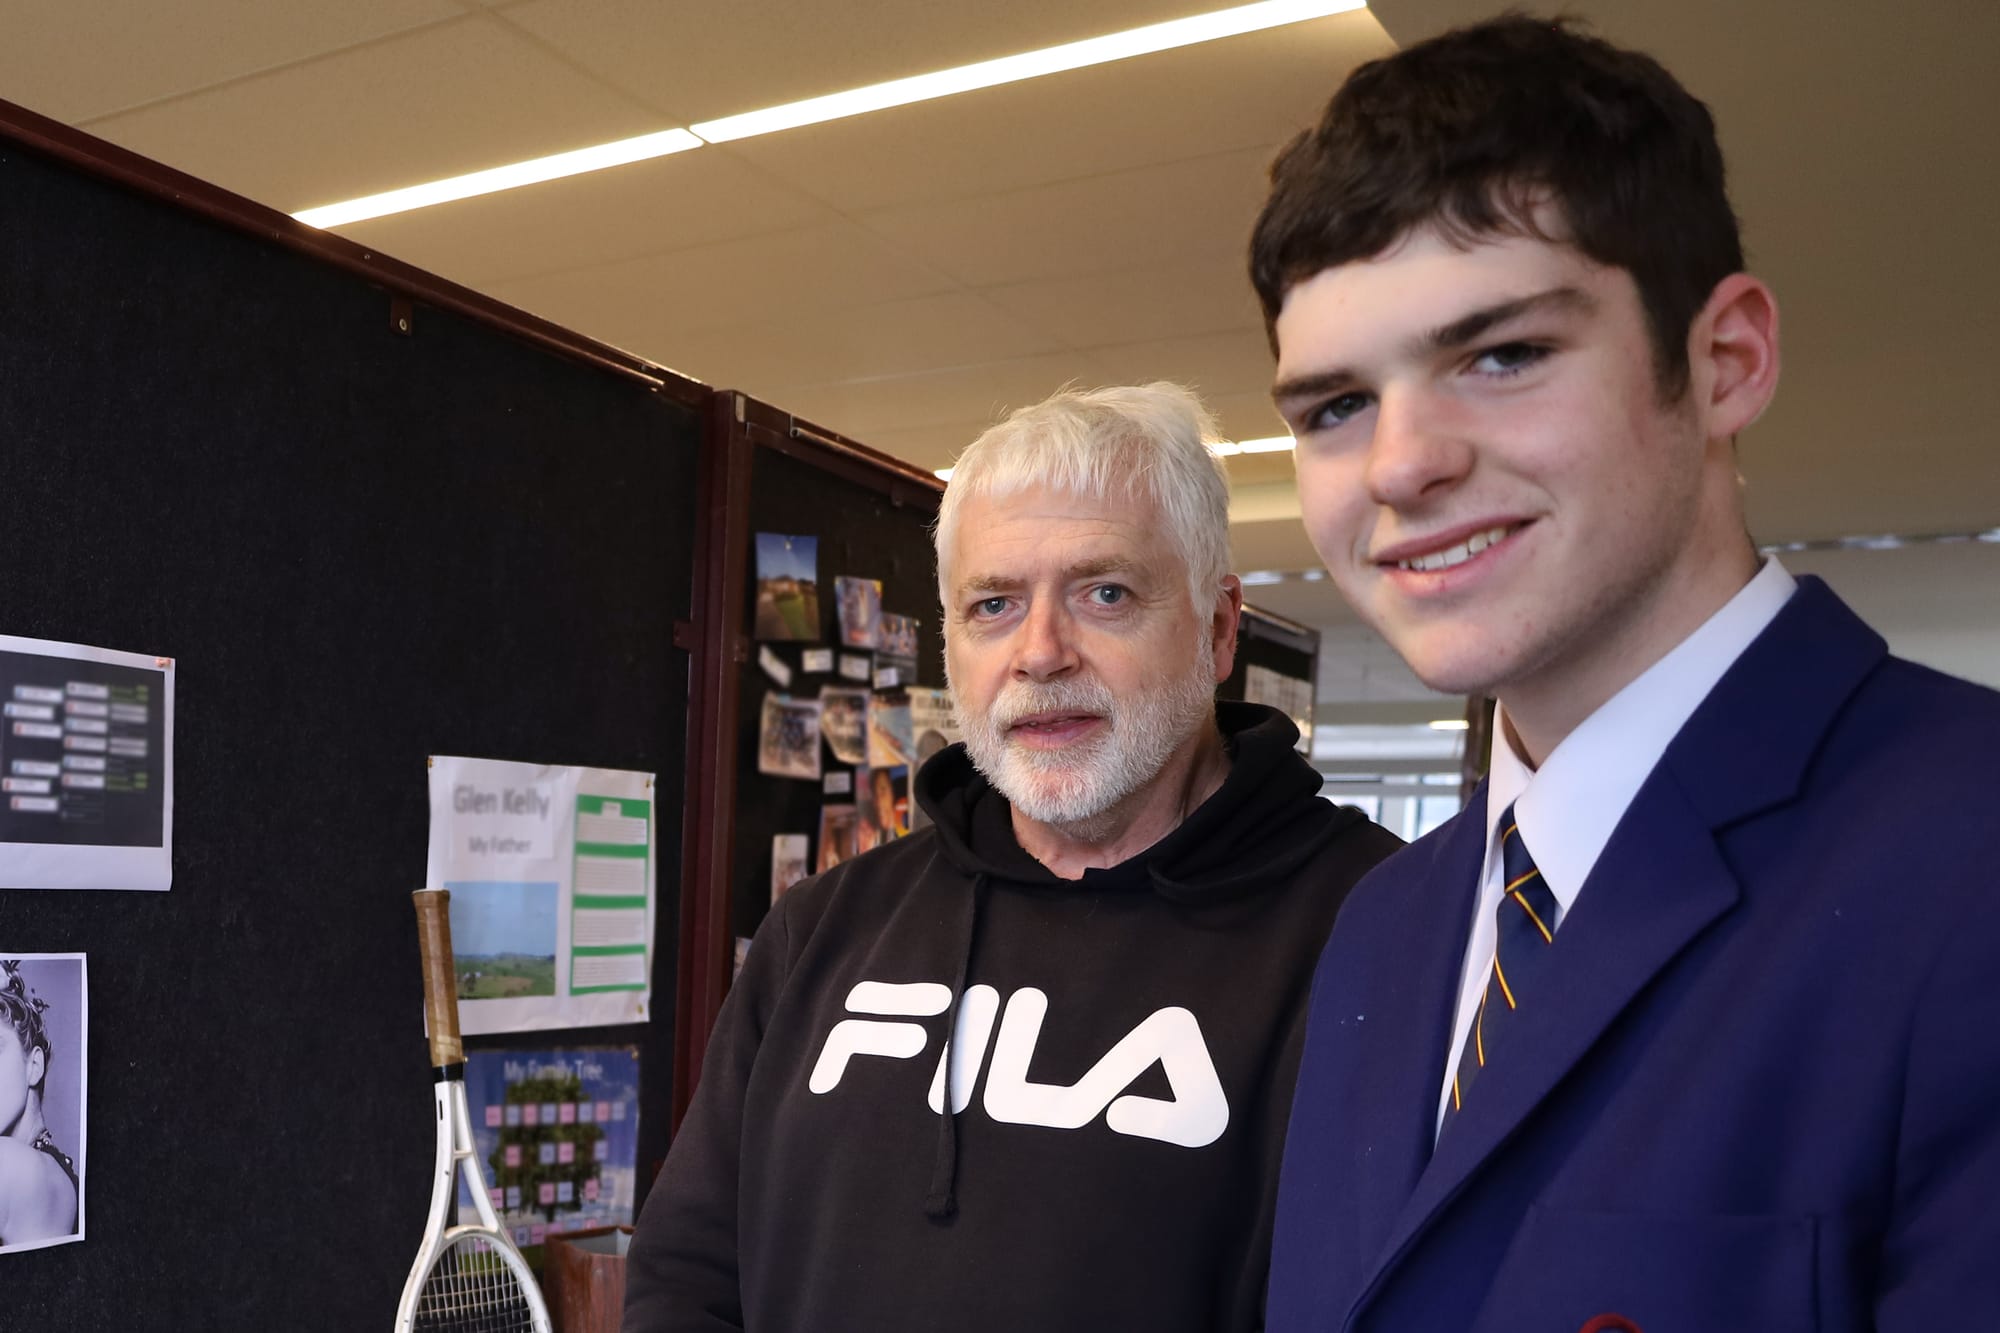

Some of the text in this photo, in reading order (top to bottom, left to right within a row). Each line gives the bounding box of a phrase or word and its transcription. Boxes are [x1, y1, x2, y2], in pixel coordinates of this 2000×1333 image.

[453, 784, 550, 822] Glen Kelly
[468, 836, 532, 857] My Father
[504, 1059, 603, 1086] My Family Tree
[809, 980, 1230, 1148] FILA
